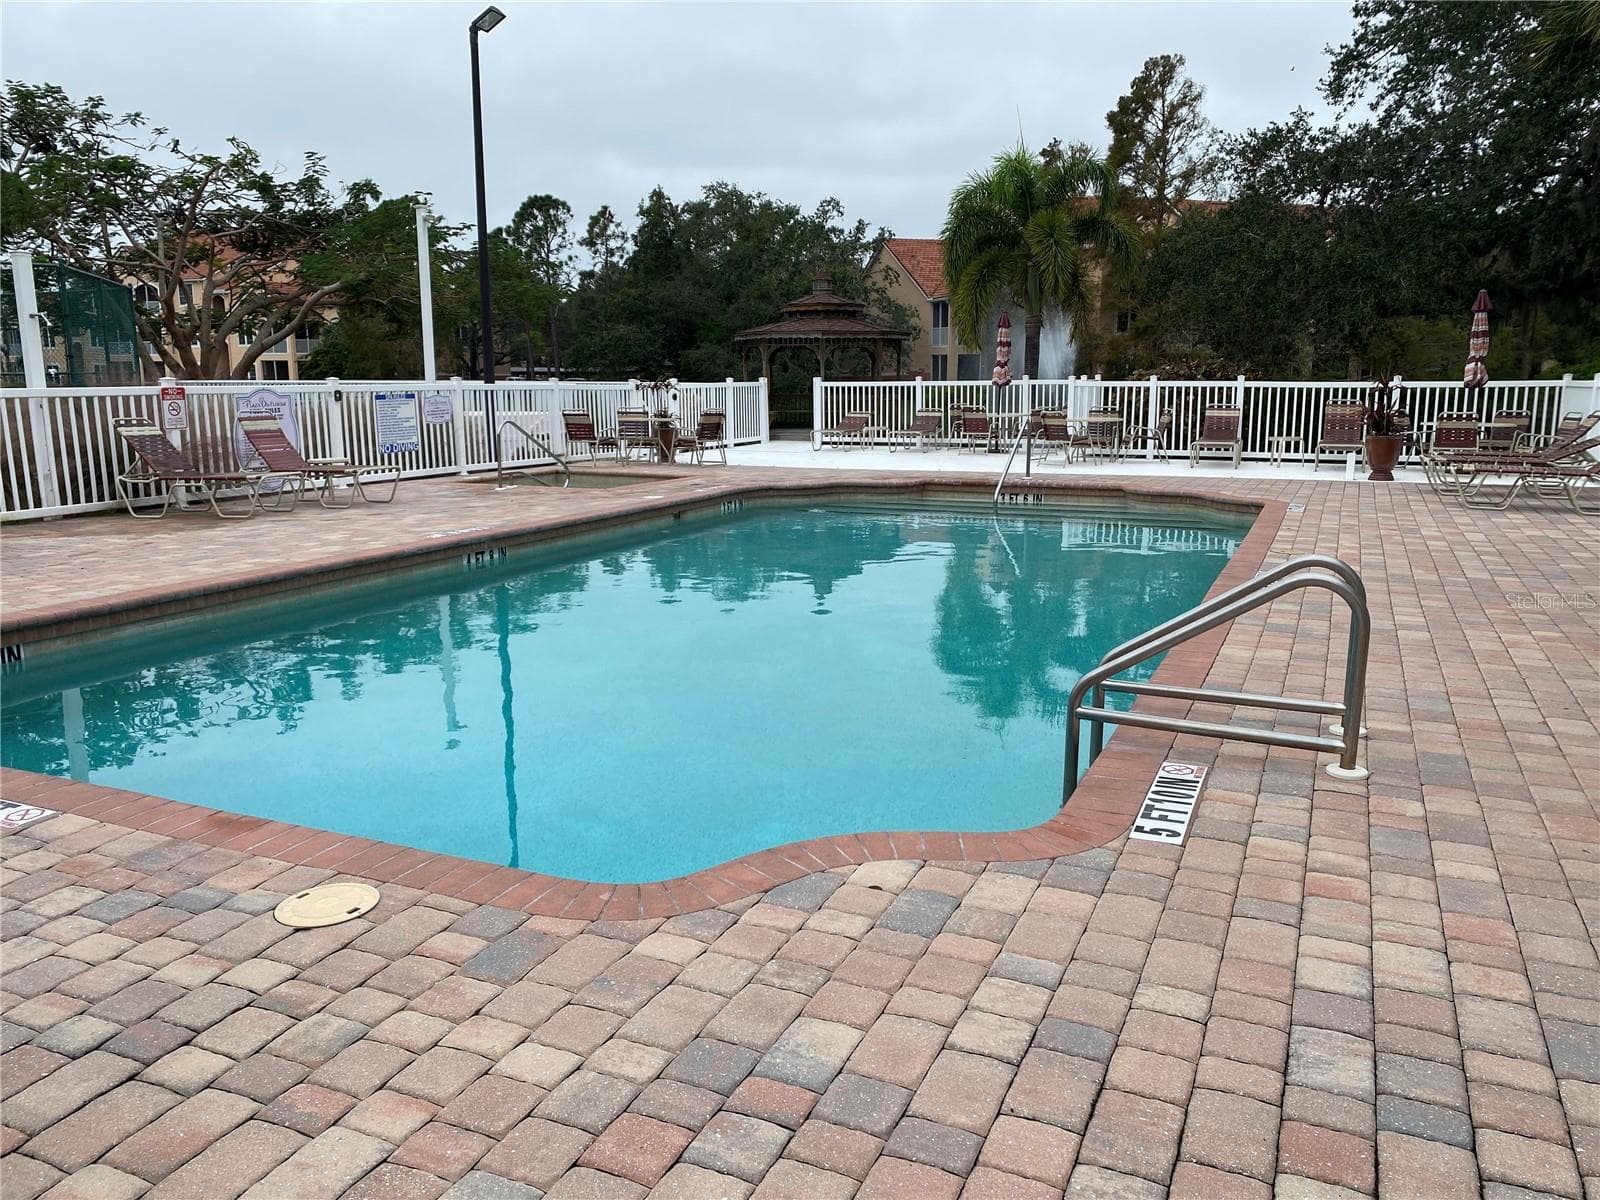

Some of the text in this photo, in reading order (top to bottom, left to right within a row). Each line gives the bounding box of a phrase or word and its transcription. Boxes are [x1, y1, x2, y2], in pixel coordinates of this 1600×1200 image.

[380, 442, 419, 453] NO DIVING
[1033, 494, 1043, 504] IN
